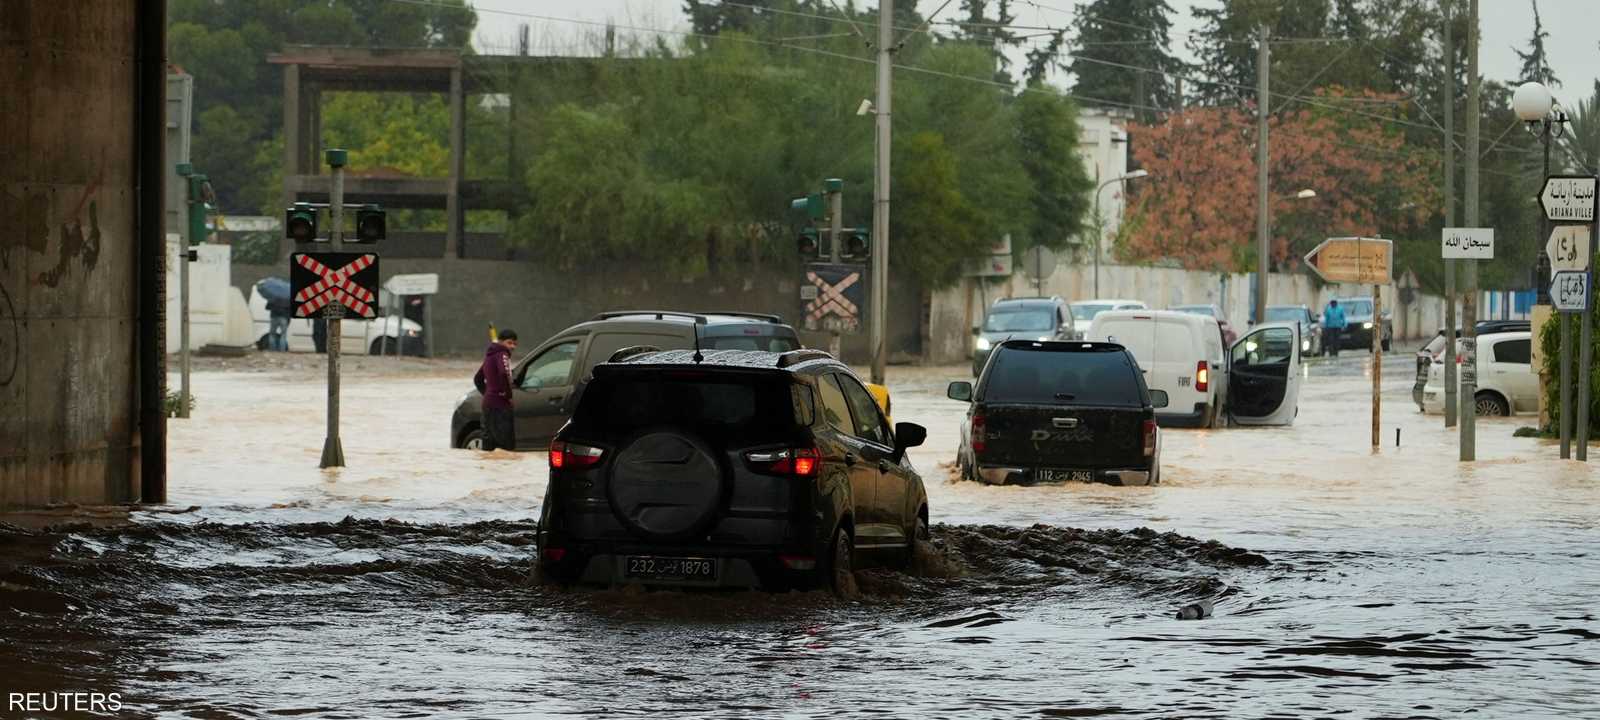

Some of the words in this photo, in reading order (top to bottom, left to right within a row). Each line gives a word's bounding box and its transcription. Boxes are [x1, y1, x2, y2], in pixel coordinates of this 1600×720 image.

[1550, 181, 1572, 206] أريانة
[1573, 182, 1593, 203] مدينة
[1550, 207, 1573, 217] ARIANA
[1575, 207, 1592, 217] VILLE
[1445, 236, 1460, 247] الله
[1463, 236, 1489, 251] سبحان
[1040, 470, 1053, 480] 112
[631, 559, 655, 573] 232
[681, 561, 710, 575] 1878
